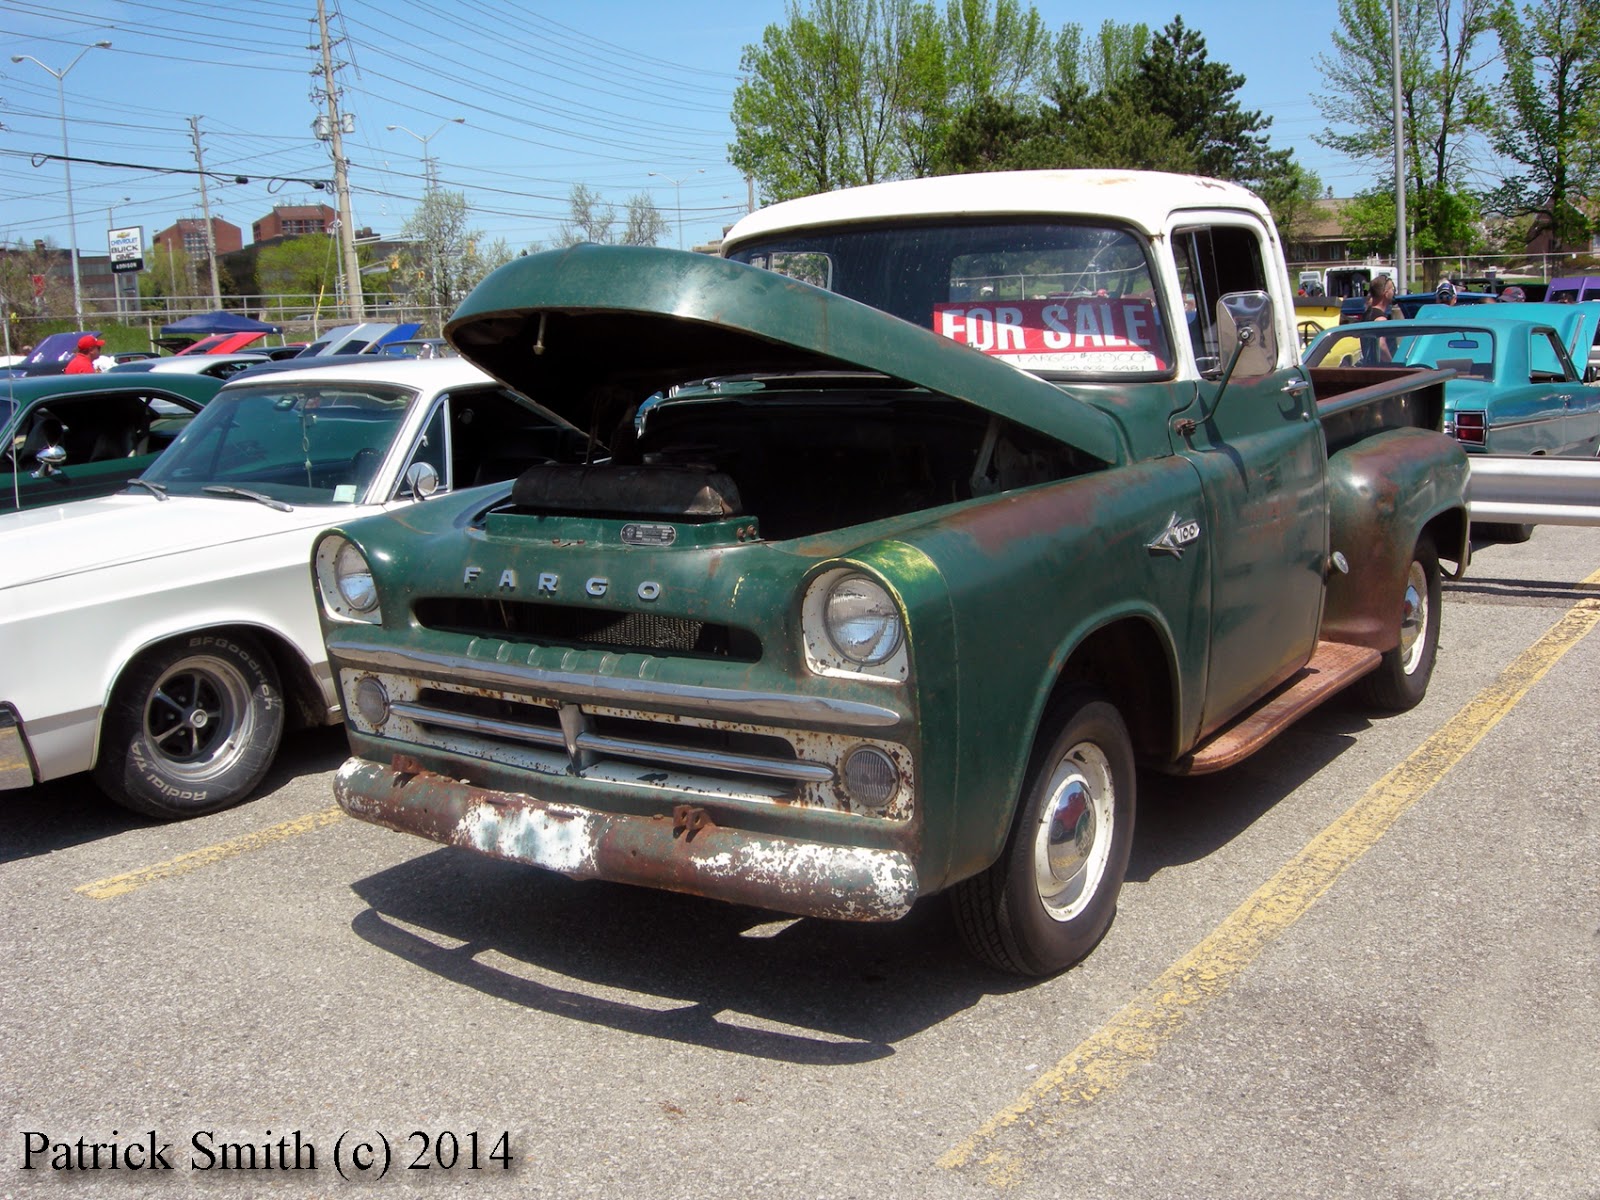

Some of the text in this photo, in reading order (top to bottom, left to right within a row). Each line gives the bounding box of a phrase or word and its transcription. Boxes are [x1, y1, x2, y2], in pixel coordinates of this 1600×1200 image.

[111, 237, 138, 246] CHEVROLET
[111, 245, 139, 254] BUICK
[116, 252, 135, 260] GMC
[942, 304, 1150, 350] FOR SALE
[1179, 524, 1196, 542] 100
[463, 567, 661, 600] FARGO
[146, 774, 208, 801] Radial
